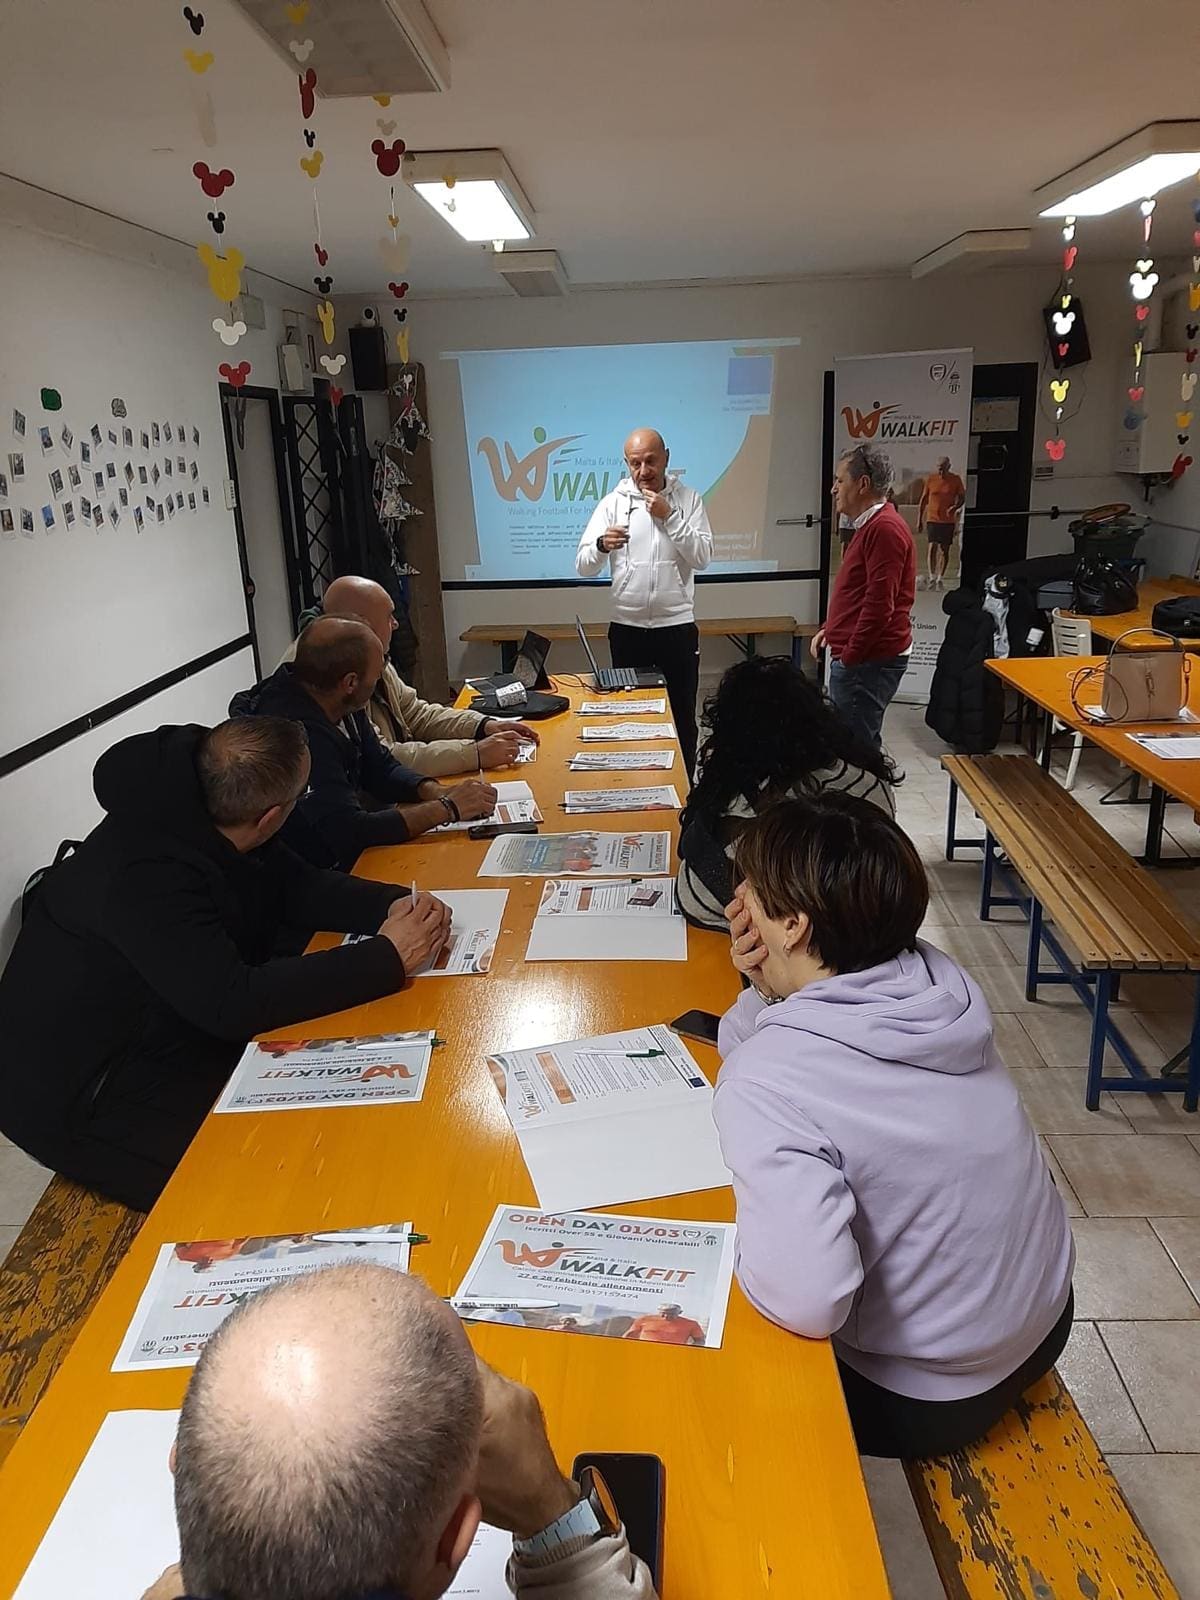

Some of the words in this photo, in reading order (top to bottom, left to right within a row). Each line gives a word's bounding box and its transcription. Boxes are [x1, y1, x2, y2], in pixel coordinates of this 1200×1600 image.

[881, 420, 958, 437] WALKFIT
[576, 457, 596, 465] Malta
[508, 507, 536, 516] Walking
[257, 1066, 362, 1078] WALKFIT
[265, 1095, 316, 1103] 01/03
[508, 1214, 566, 1226] OPEN
[572, 1220, 614, 1231] DAY
[619, 1224, 680, 1238] 01/03
[606, 1234, 643, 1242] Giovani
[646, 1238, 700, 1247] Vulnerabili
[560, 1259, 696, 1282] WALKFIT
[554, 1277, 598, 1288] febbraio
[600, 1282, 664, 1294] allenamenti
